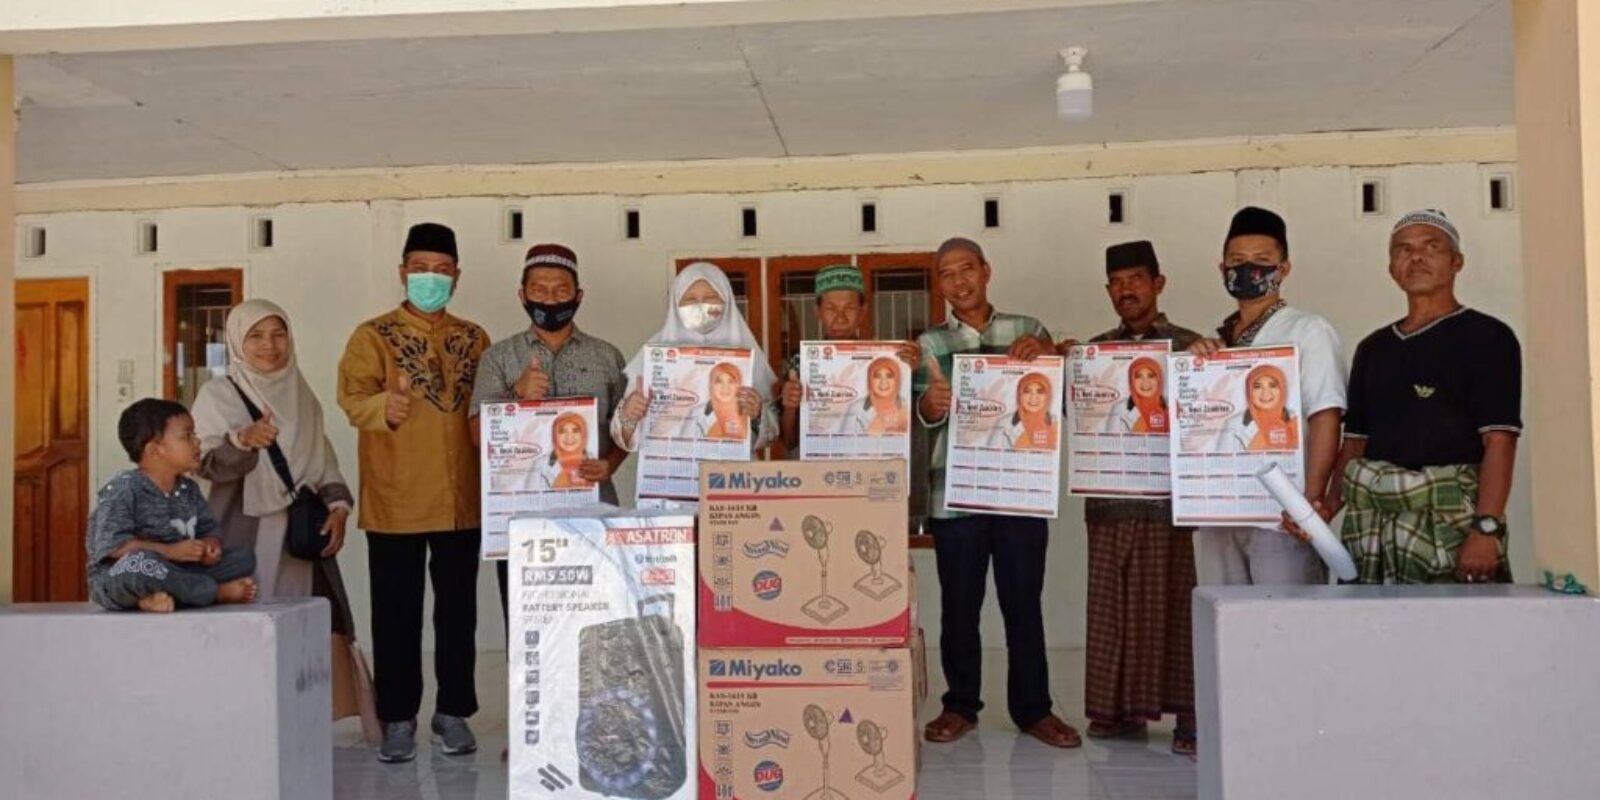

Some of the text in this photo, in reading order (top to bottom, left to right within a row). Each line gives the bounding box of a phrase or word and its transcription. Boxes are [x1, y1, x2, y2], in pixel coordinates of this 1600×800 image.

[729, 470, 802, 493] Miyako
[627, 528, 687, 543] ASATRON
[522, 538, 568, 563] 15"
[524, 569, 590, 582] RMS 50W
[523, 603, 562, 612] BATTERY
[729, 657, 803, 681] Miyako
